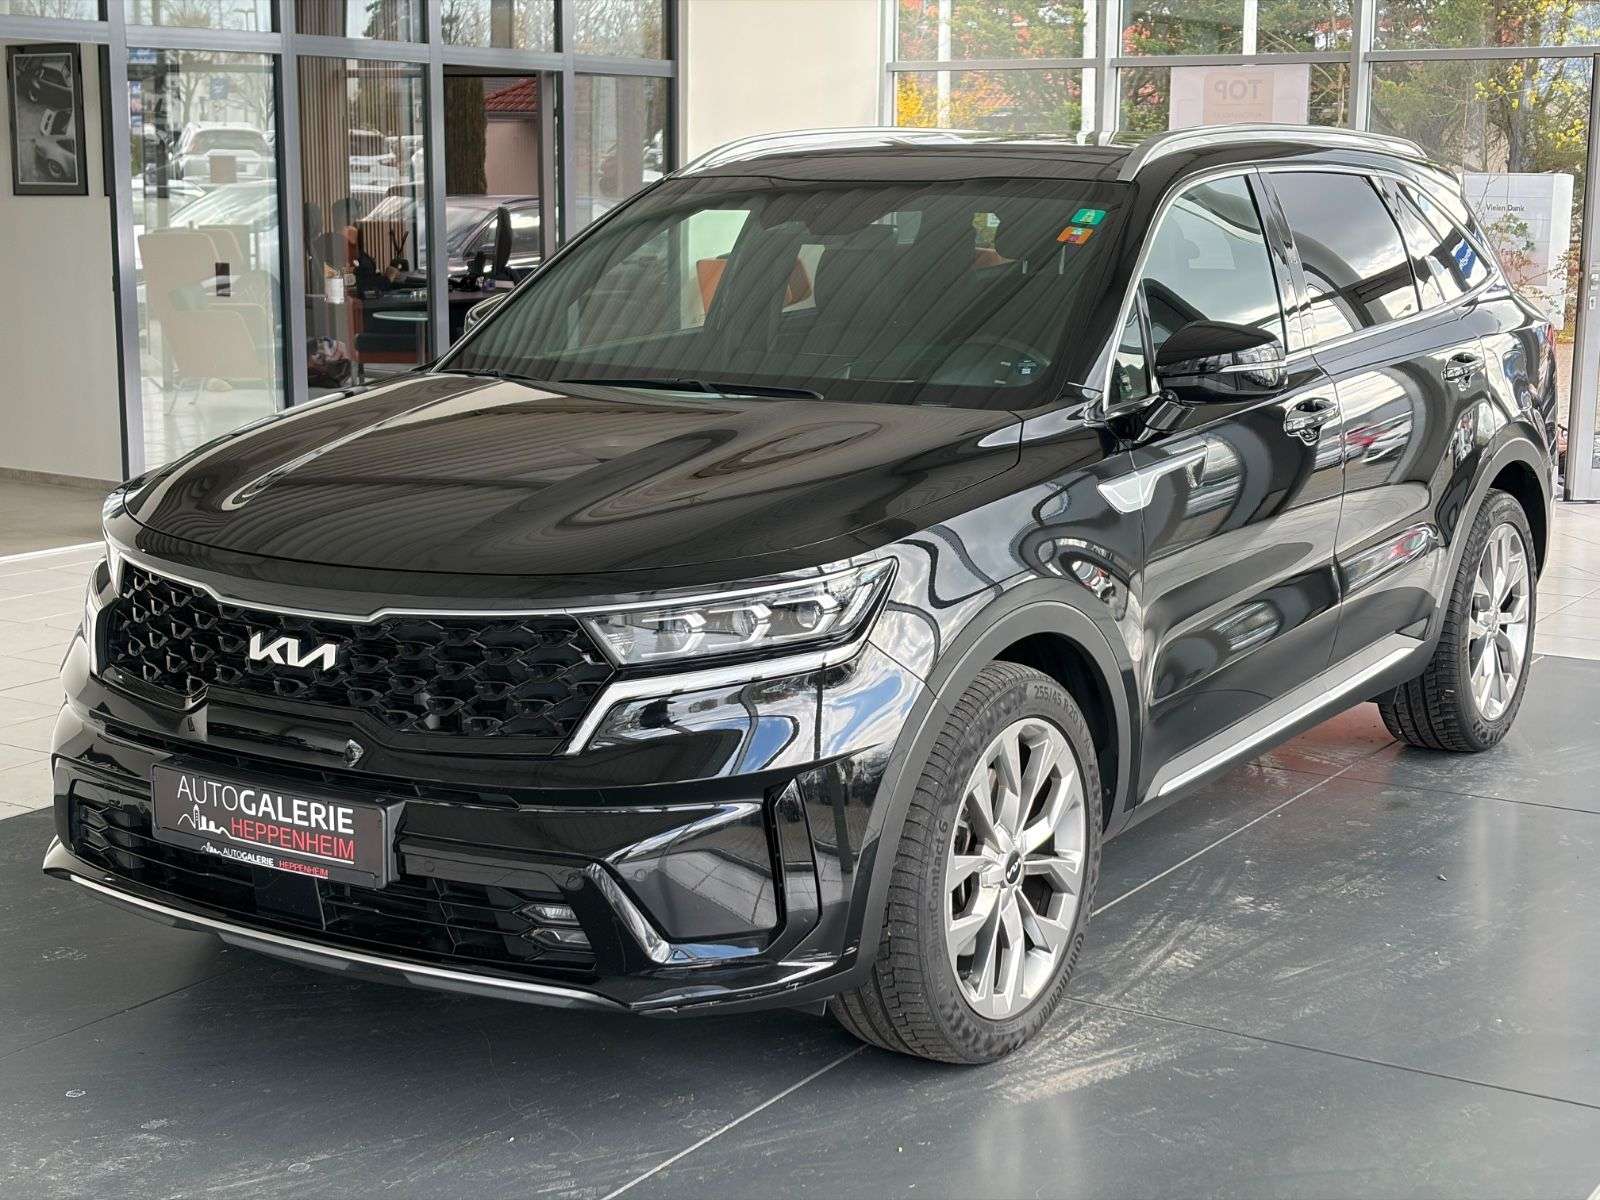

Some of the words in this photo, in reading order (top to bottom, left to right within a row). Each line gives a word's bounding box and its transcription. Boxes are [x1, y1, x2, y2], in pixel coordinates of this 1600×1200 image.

[1507, 203, 1525, 212] Dank
[250, 633, 336, 671] KIA
[177, 775, 354, 835] AUTOGALERIE
[231, 817, 354, 860] HEPPENHEIM
[222, 847, 274, 867] AUTOGALERIE
[279, 860, 329, 877] HEPPENHEIM
